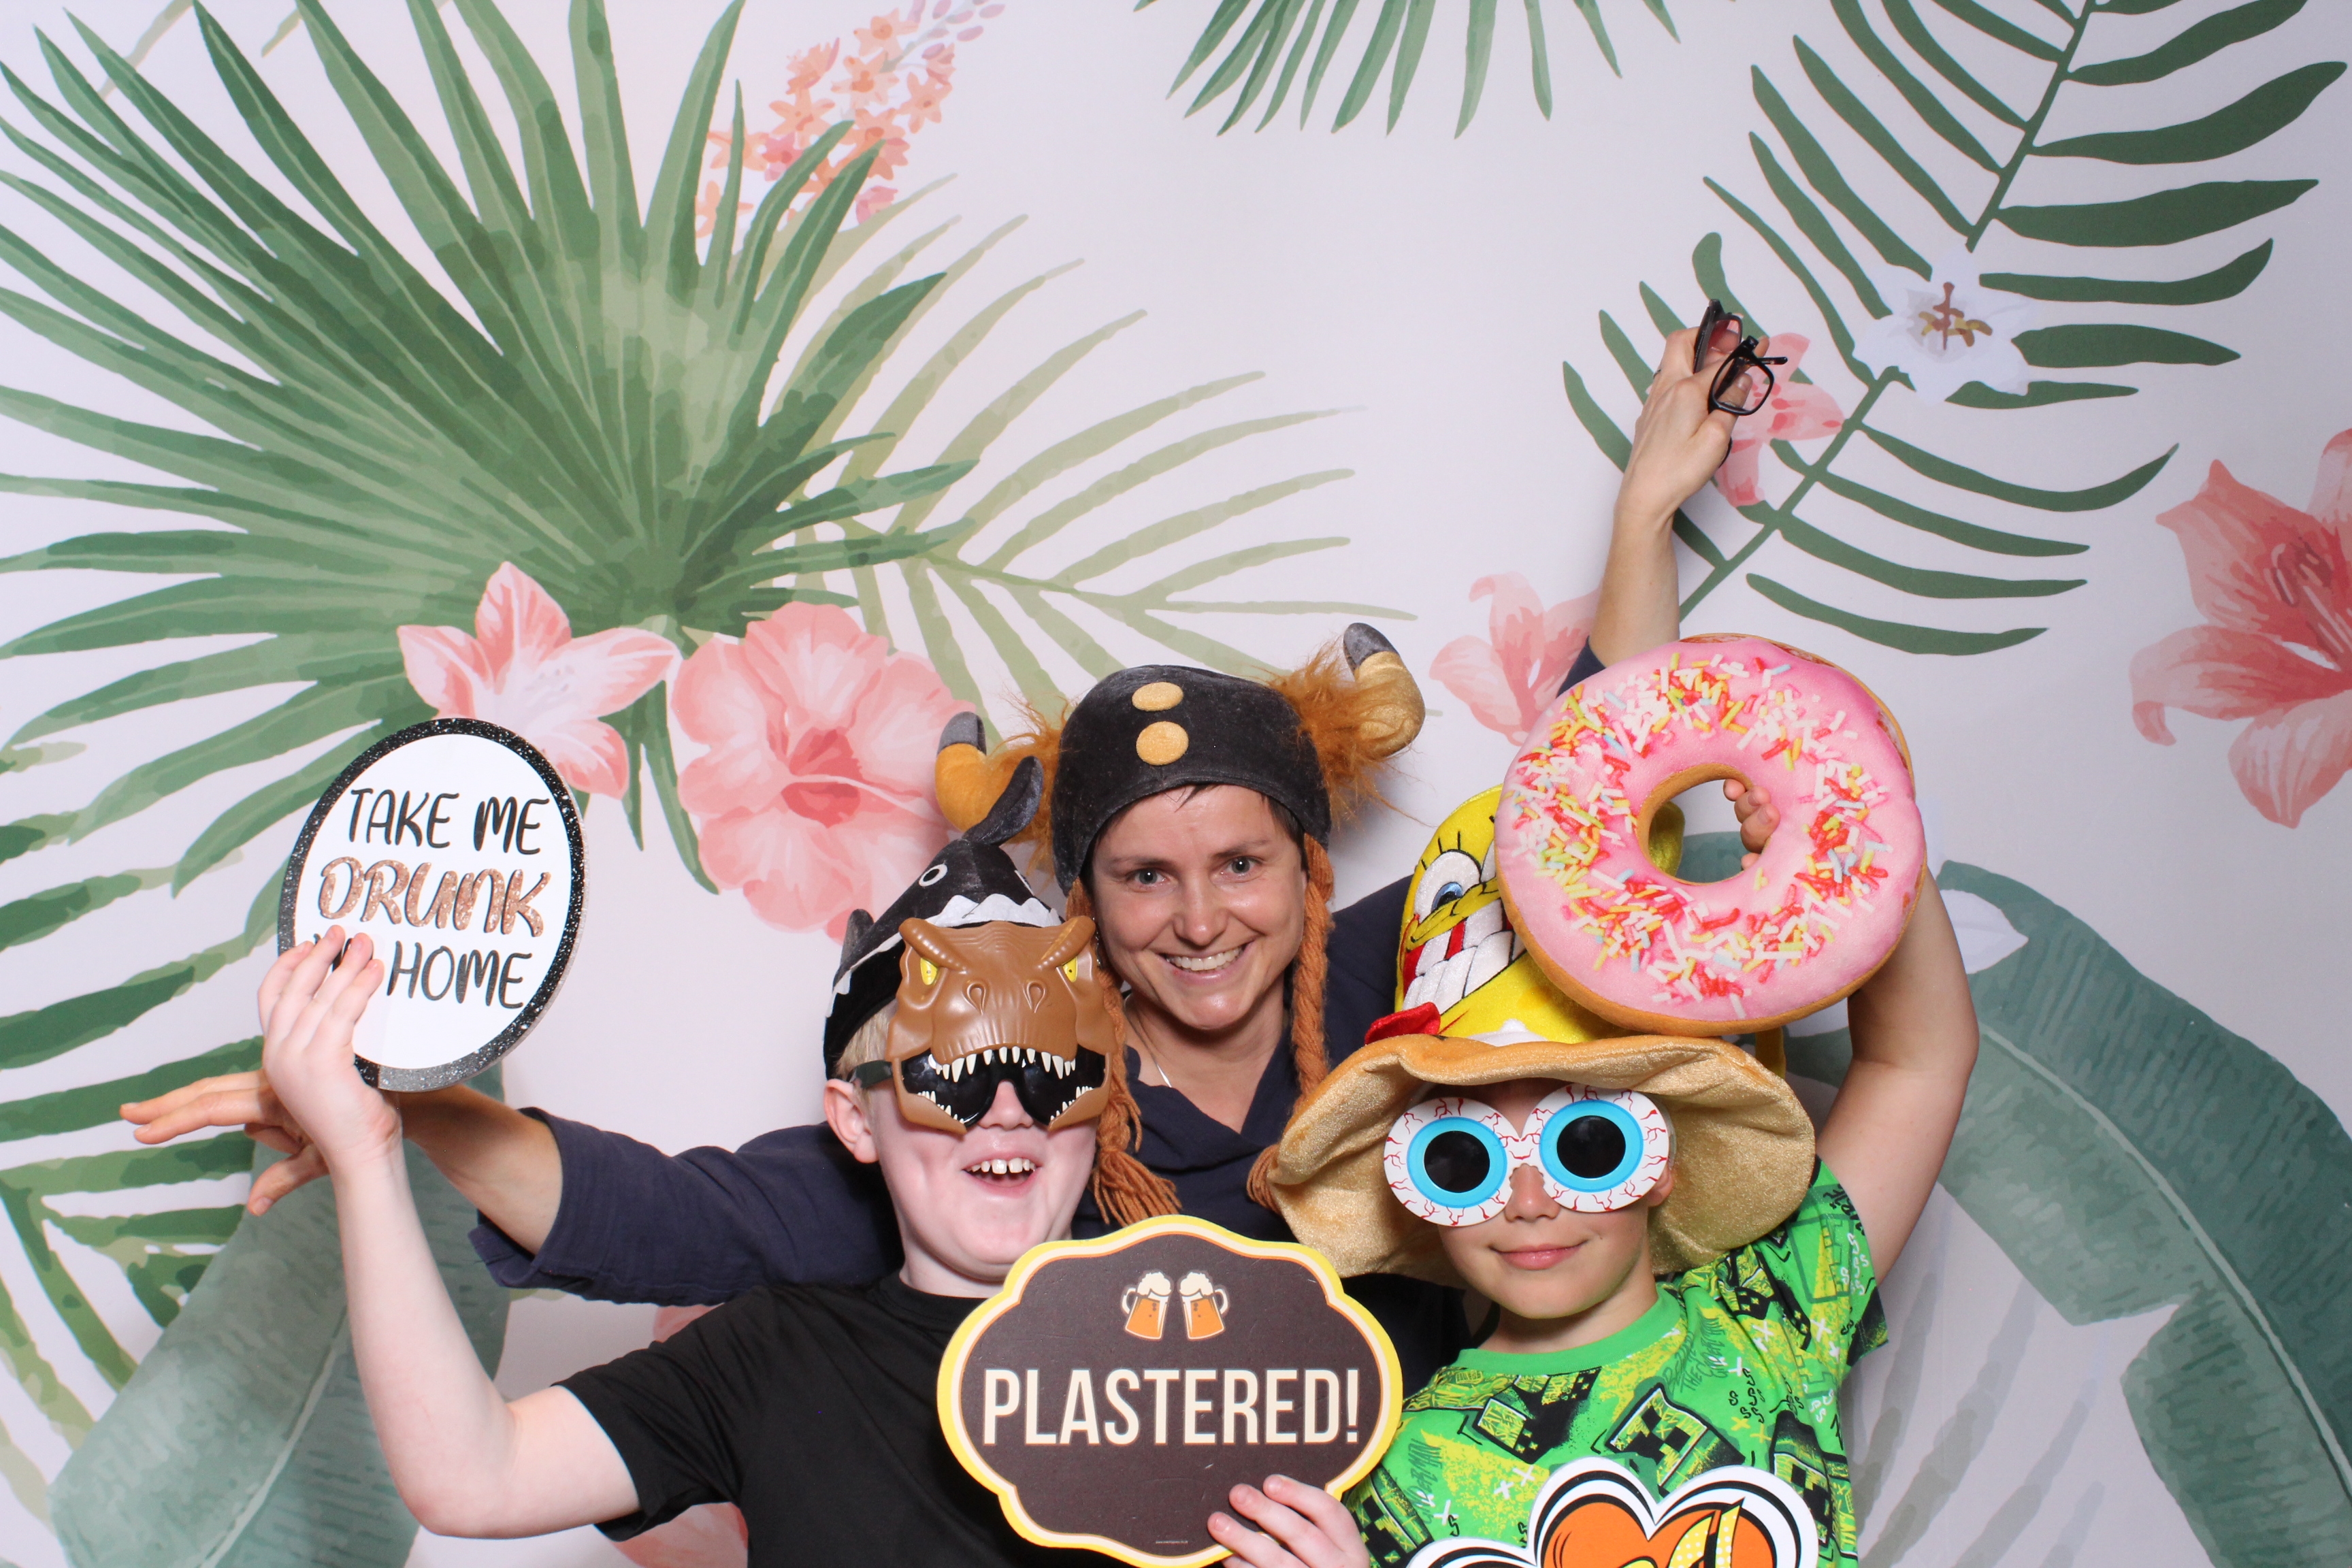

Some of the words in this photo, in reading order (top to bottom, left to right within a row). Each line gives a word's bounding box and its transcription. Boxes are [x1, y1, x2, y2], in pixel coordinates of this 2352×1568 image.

[348, 788, 459, 849] TAKE
[474, 796, 550, 855] ME
[318, 855, 552, 937] DRUNK
[387, 940, 533, 1009] HOME
[983, 1369, 1359, 1446] PLASTERED!
